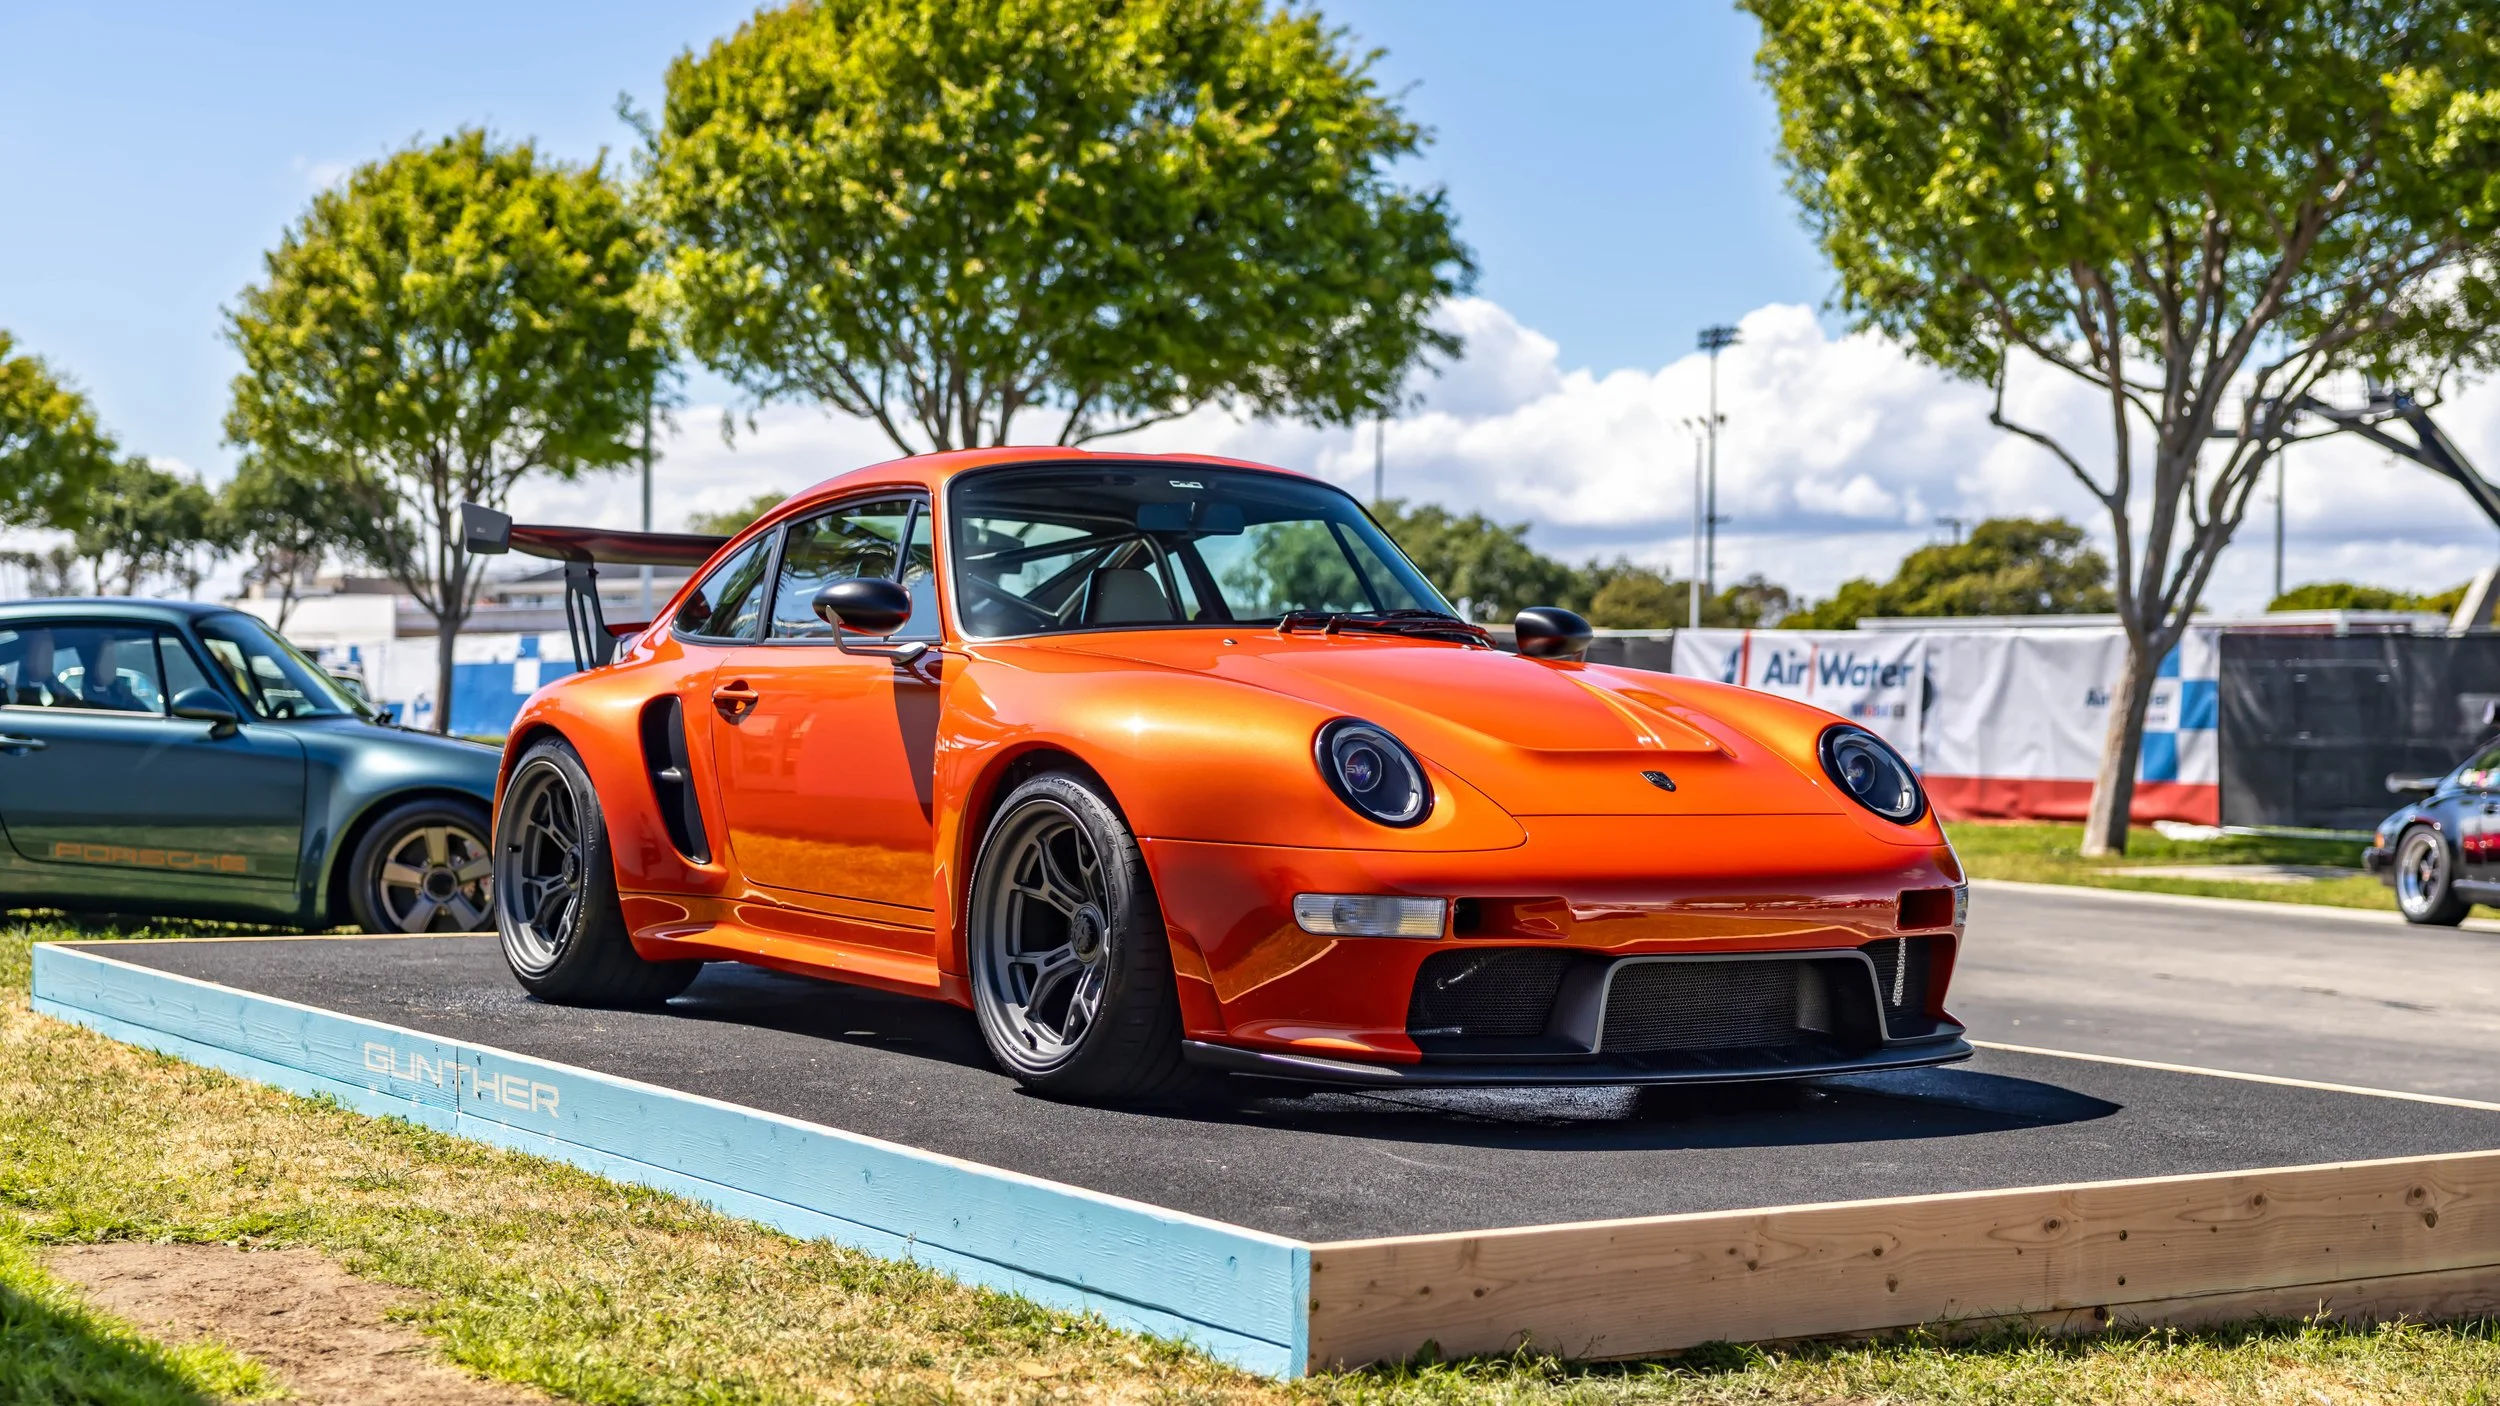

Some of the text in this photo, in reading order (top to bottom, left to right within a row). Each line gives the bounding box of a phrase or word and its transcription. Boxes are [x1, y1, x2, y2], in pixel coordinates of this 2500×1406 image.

[1819, 653, 1914, 687] Water
[55, 841, 247, 873] PORSCHE
[363, 1041, 560, 1118] GUNTHER
